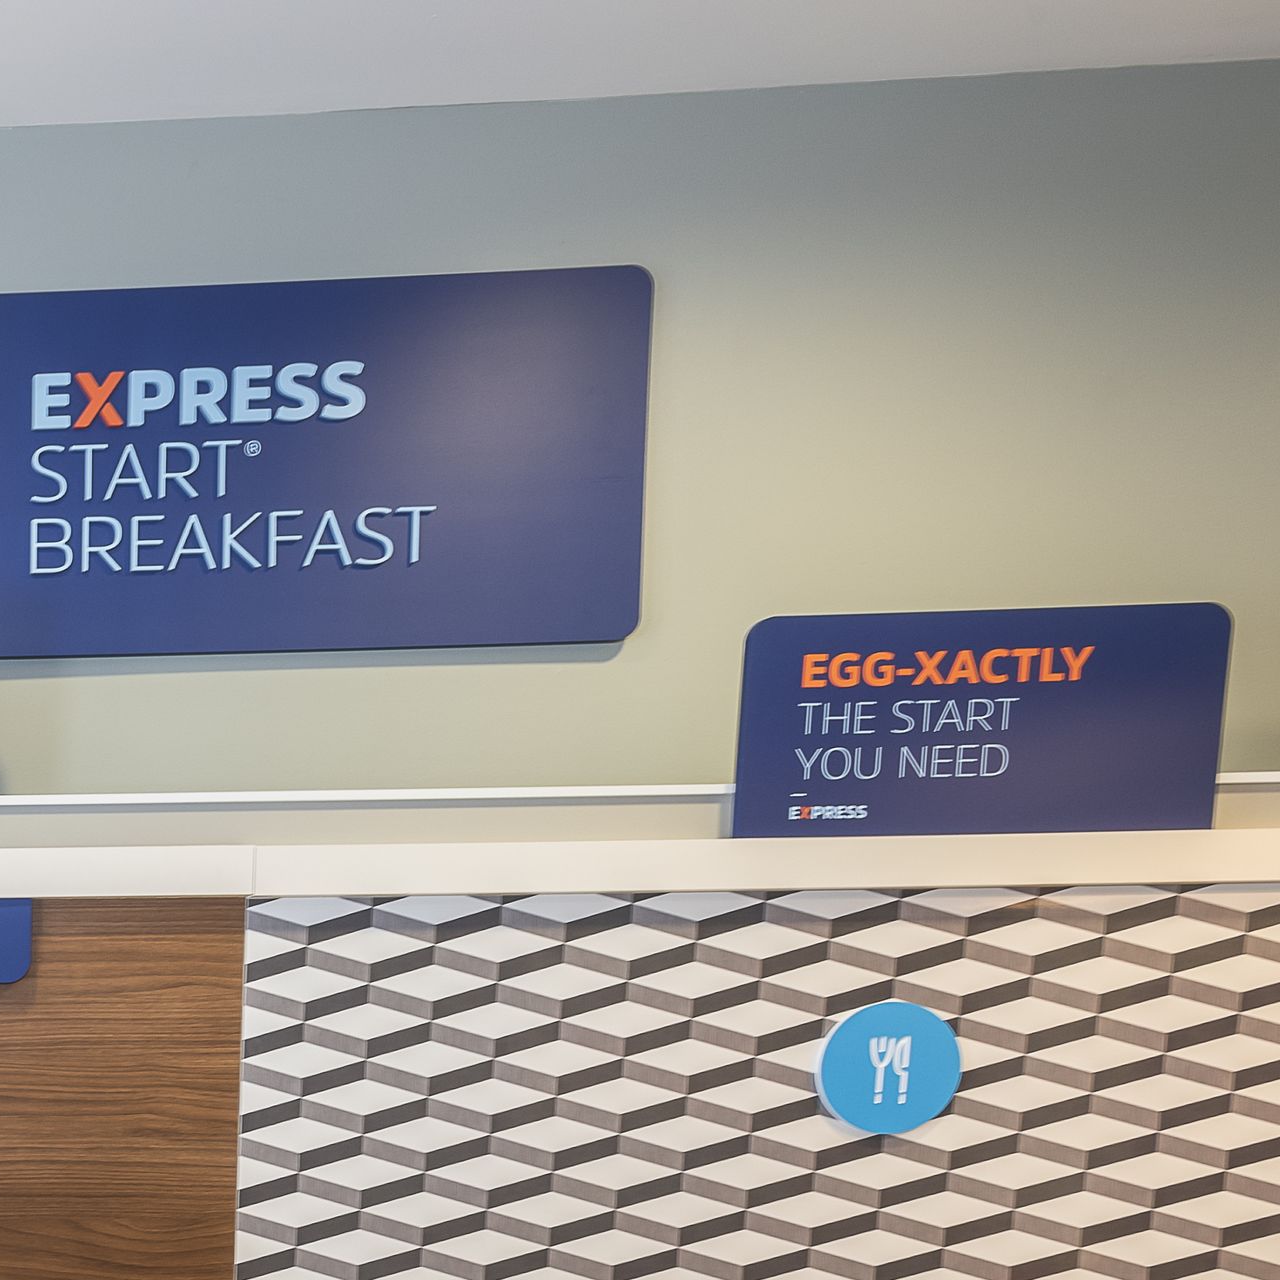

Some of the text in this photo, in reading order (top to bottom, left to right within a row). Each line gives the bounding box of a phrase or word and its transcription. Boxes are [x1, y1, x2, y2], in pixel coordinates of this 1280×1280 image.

[31, 360, 367, 431] EXPRESS
[29, 505, 438, 575] BREAKFAST
[800, 645, 1096, 689] EGG-XACTLY
[797, 696, 1021, 736] THE START
[795, 742, 1011, 782] YOU NEED
[787, 804, 869, 821] EXPRESS
